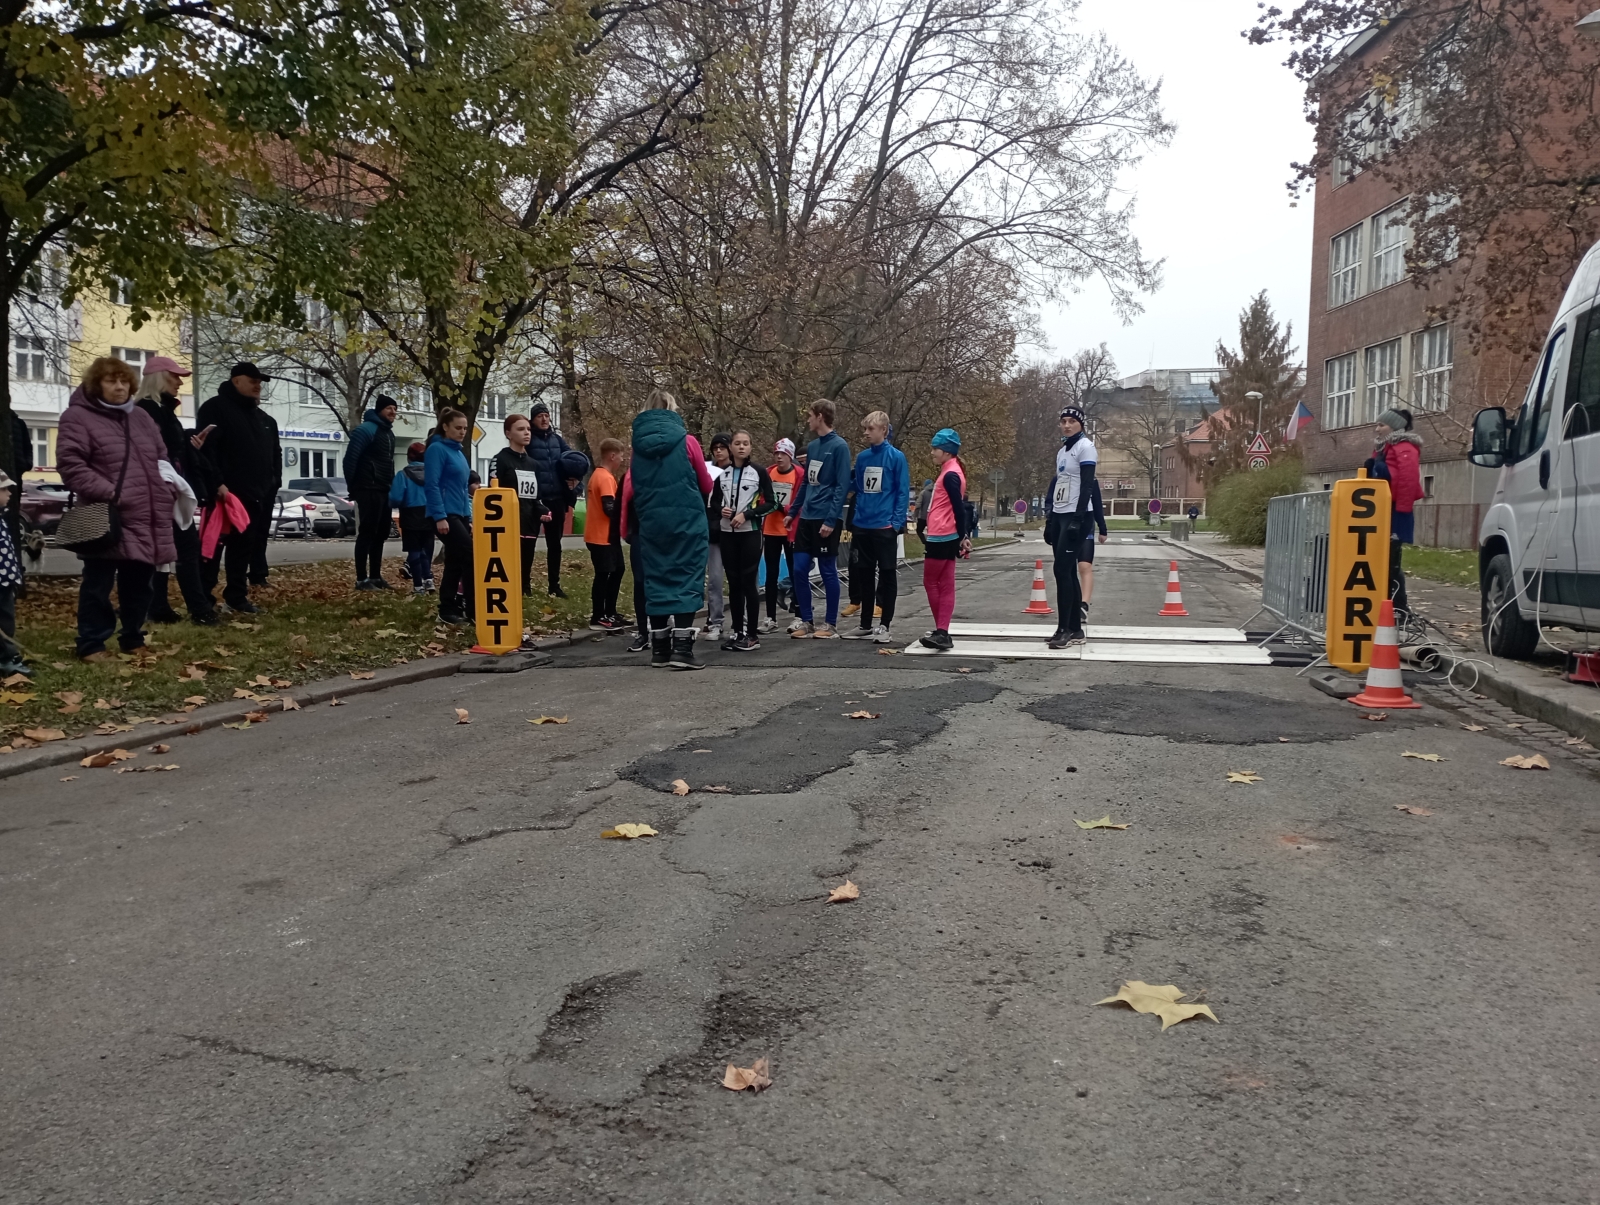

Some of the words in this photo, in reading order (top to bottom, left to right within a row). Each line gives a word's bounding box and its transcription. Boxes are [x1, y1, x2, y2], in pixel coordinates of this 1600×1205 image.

[306, 431, 330, 440] ochrany
[1252, 460, 1265, 468] 20
[520, 480, 536, 495] 136
[866, 477, 878, 490] 47
[1056, 487, 1065, 502] 61
[483, 494, 509, 645] START
[1343, 487, 1377, 663] START
